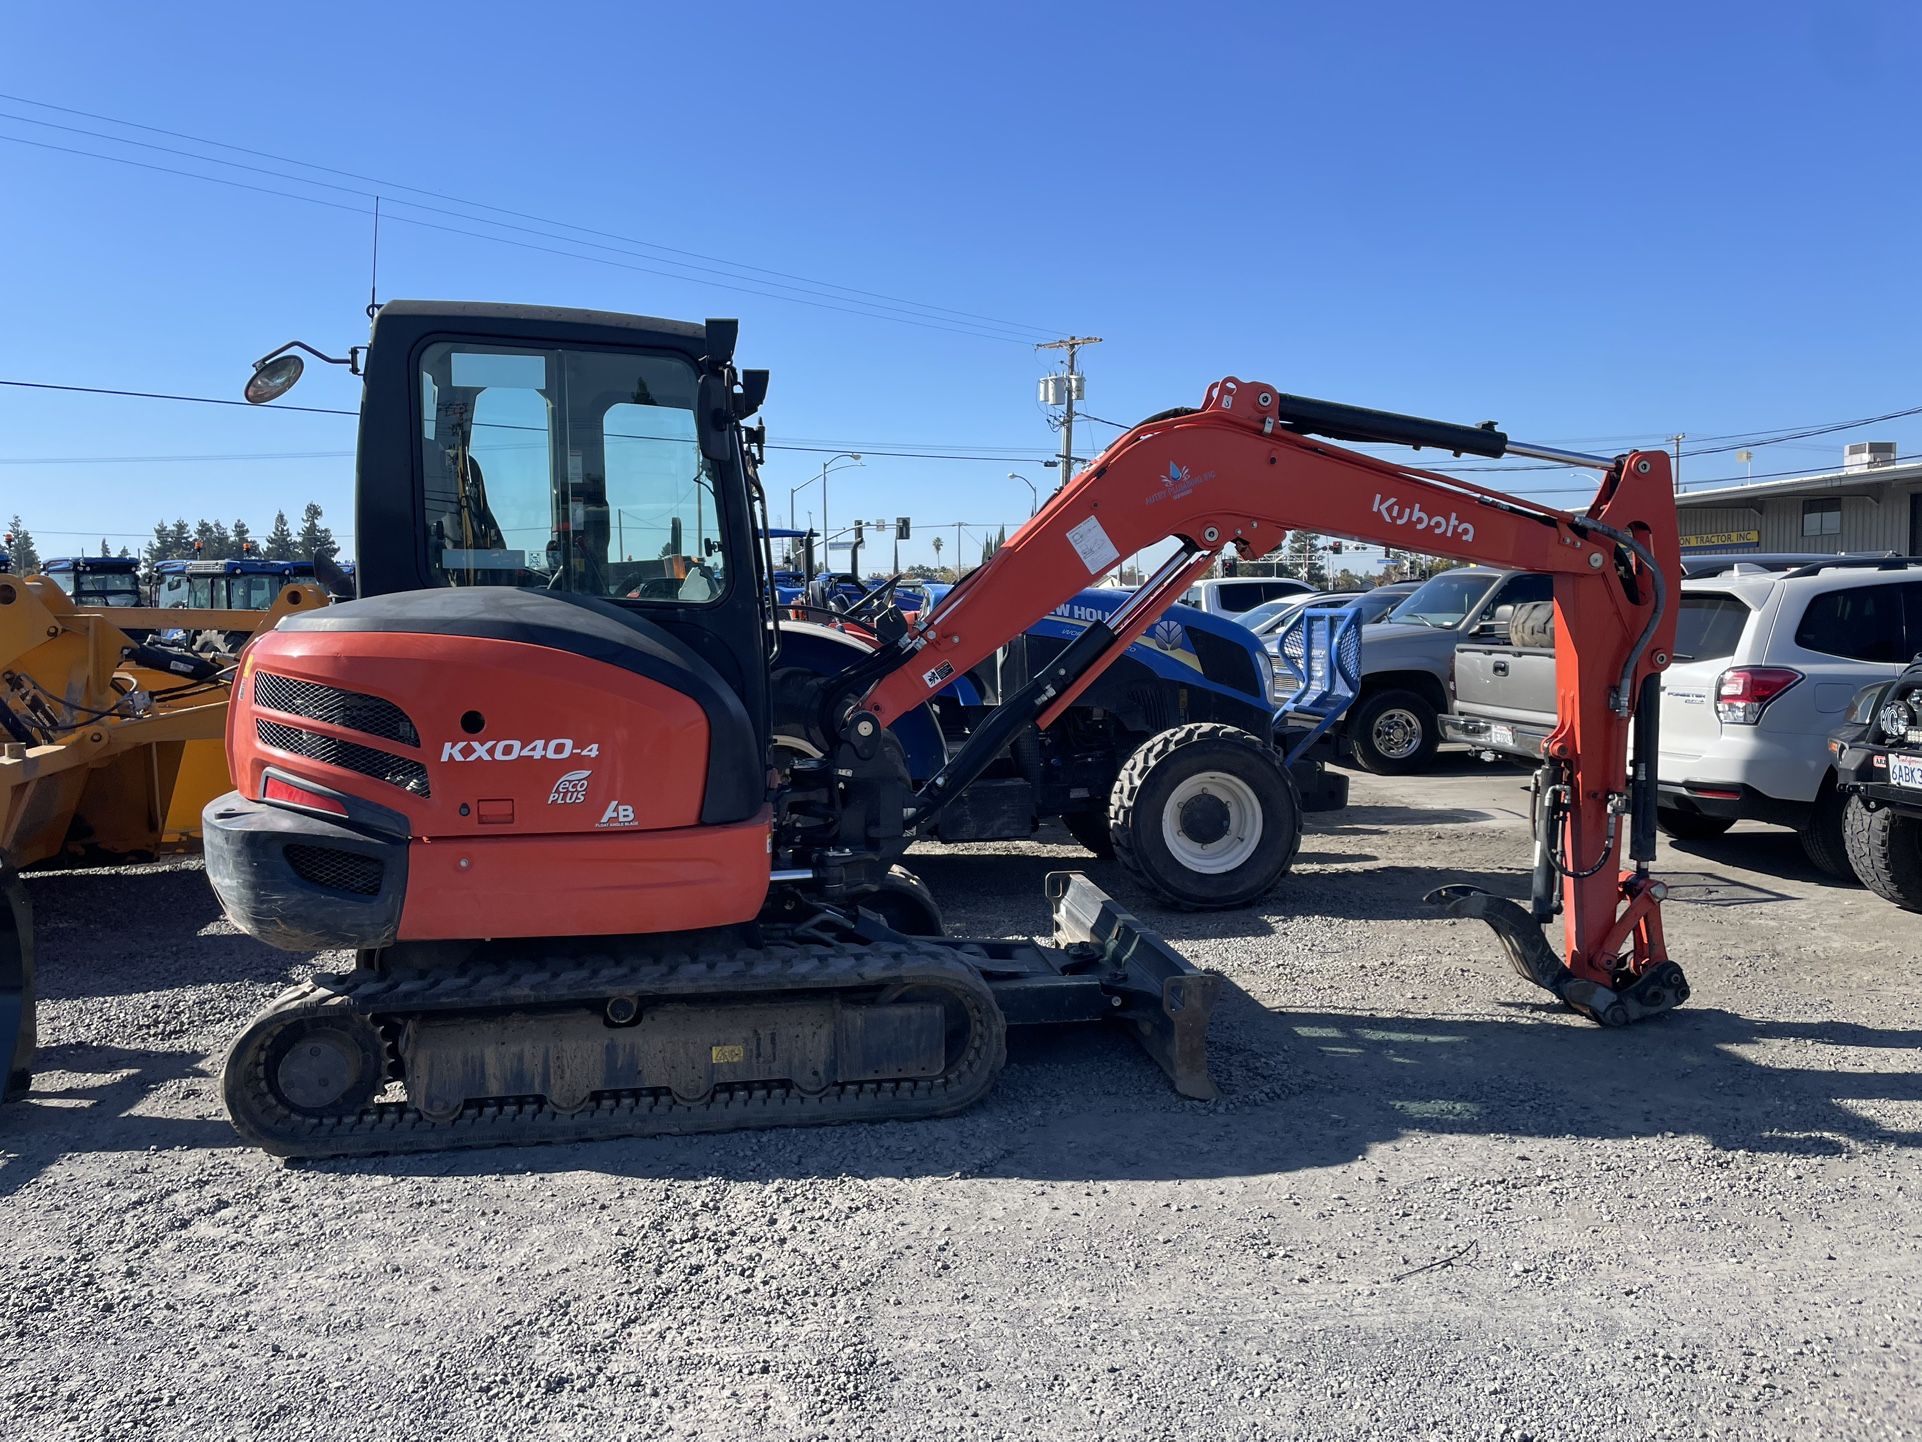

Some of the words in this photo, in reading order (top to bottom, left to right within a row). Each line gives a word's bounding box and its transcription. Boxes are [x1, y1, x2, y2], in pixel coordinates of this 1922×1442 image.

[1372, 493, 1475, 542] Kubota
[440, 738, 599, 762] KX040-4
[547, 791, 586, 804] PLUS
[558, 780, 588, 792] eco
[600, 800, 635, 823] AB
